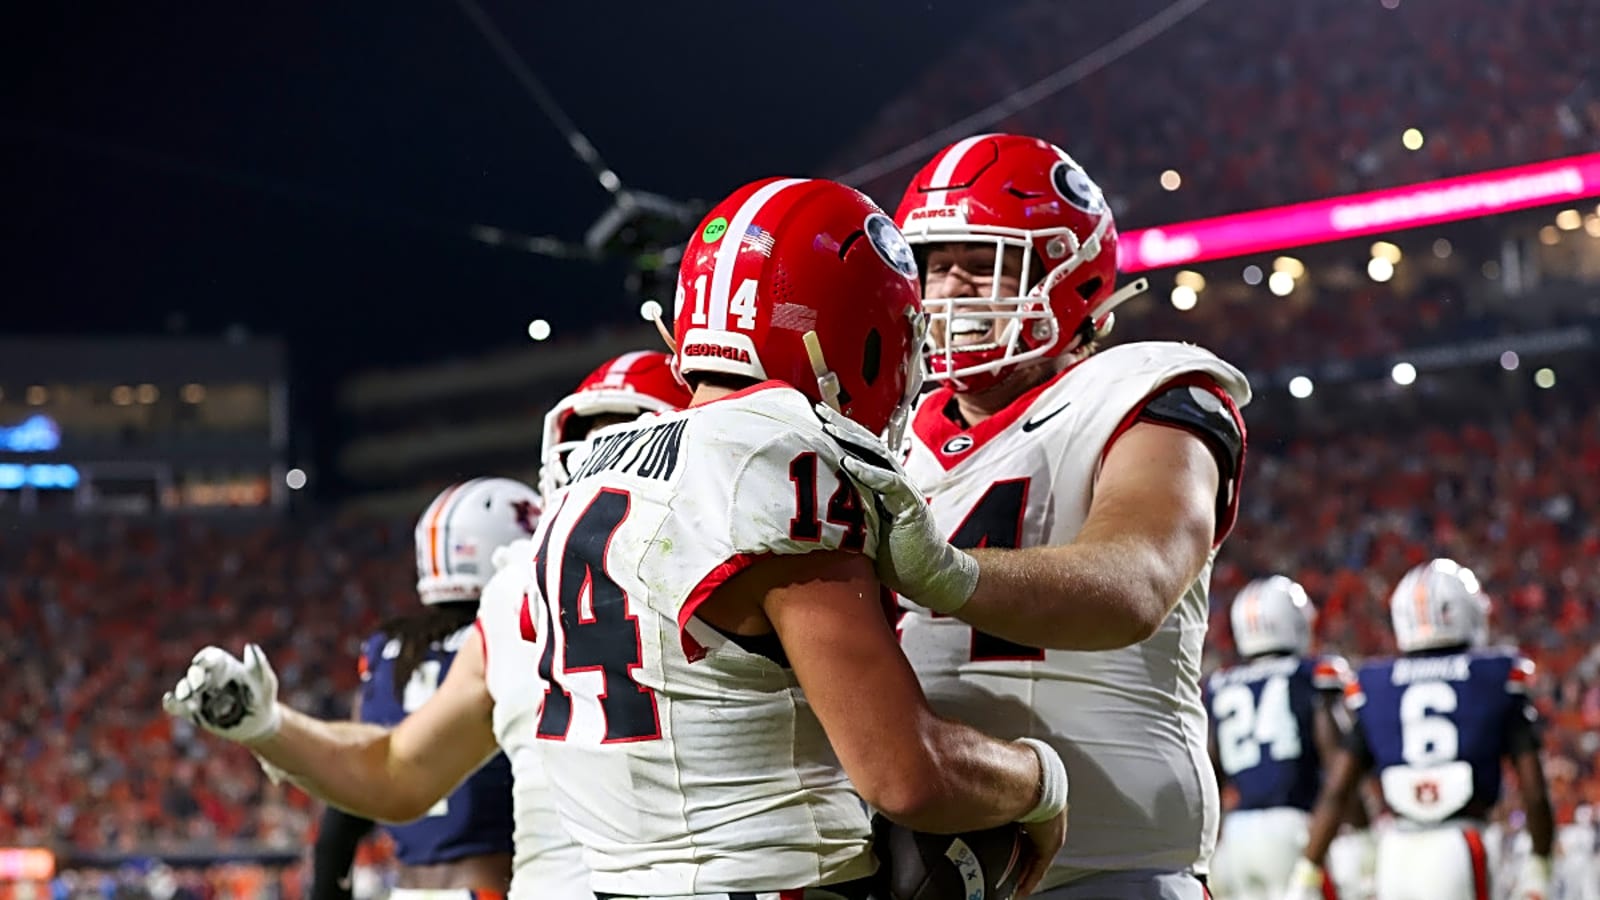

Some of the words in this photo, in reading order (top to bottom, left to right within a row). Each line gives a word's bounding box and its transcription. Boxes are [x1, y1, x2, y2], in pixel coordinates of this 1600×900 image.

[705, 224, 725, 235] C2P
[911, 208, 956, 220] DAWGS
[684, 343, 752, 365] GEORGIA
[789, 451, 867, 553] 14
[535, 487, 662, 744] 14
[1212, 676, 1302, 775] 24
[1400, 681, 1459, 767] 6
